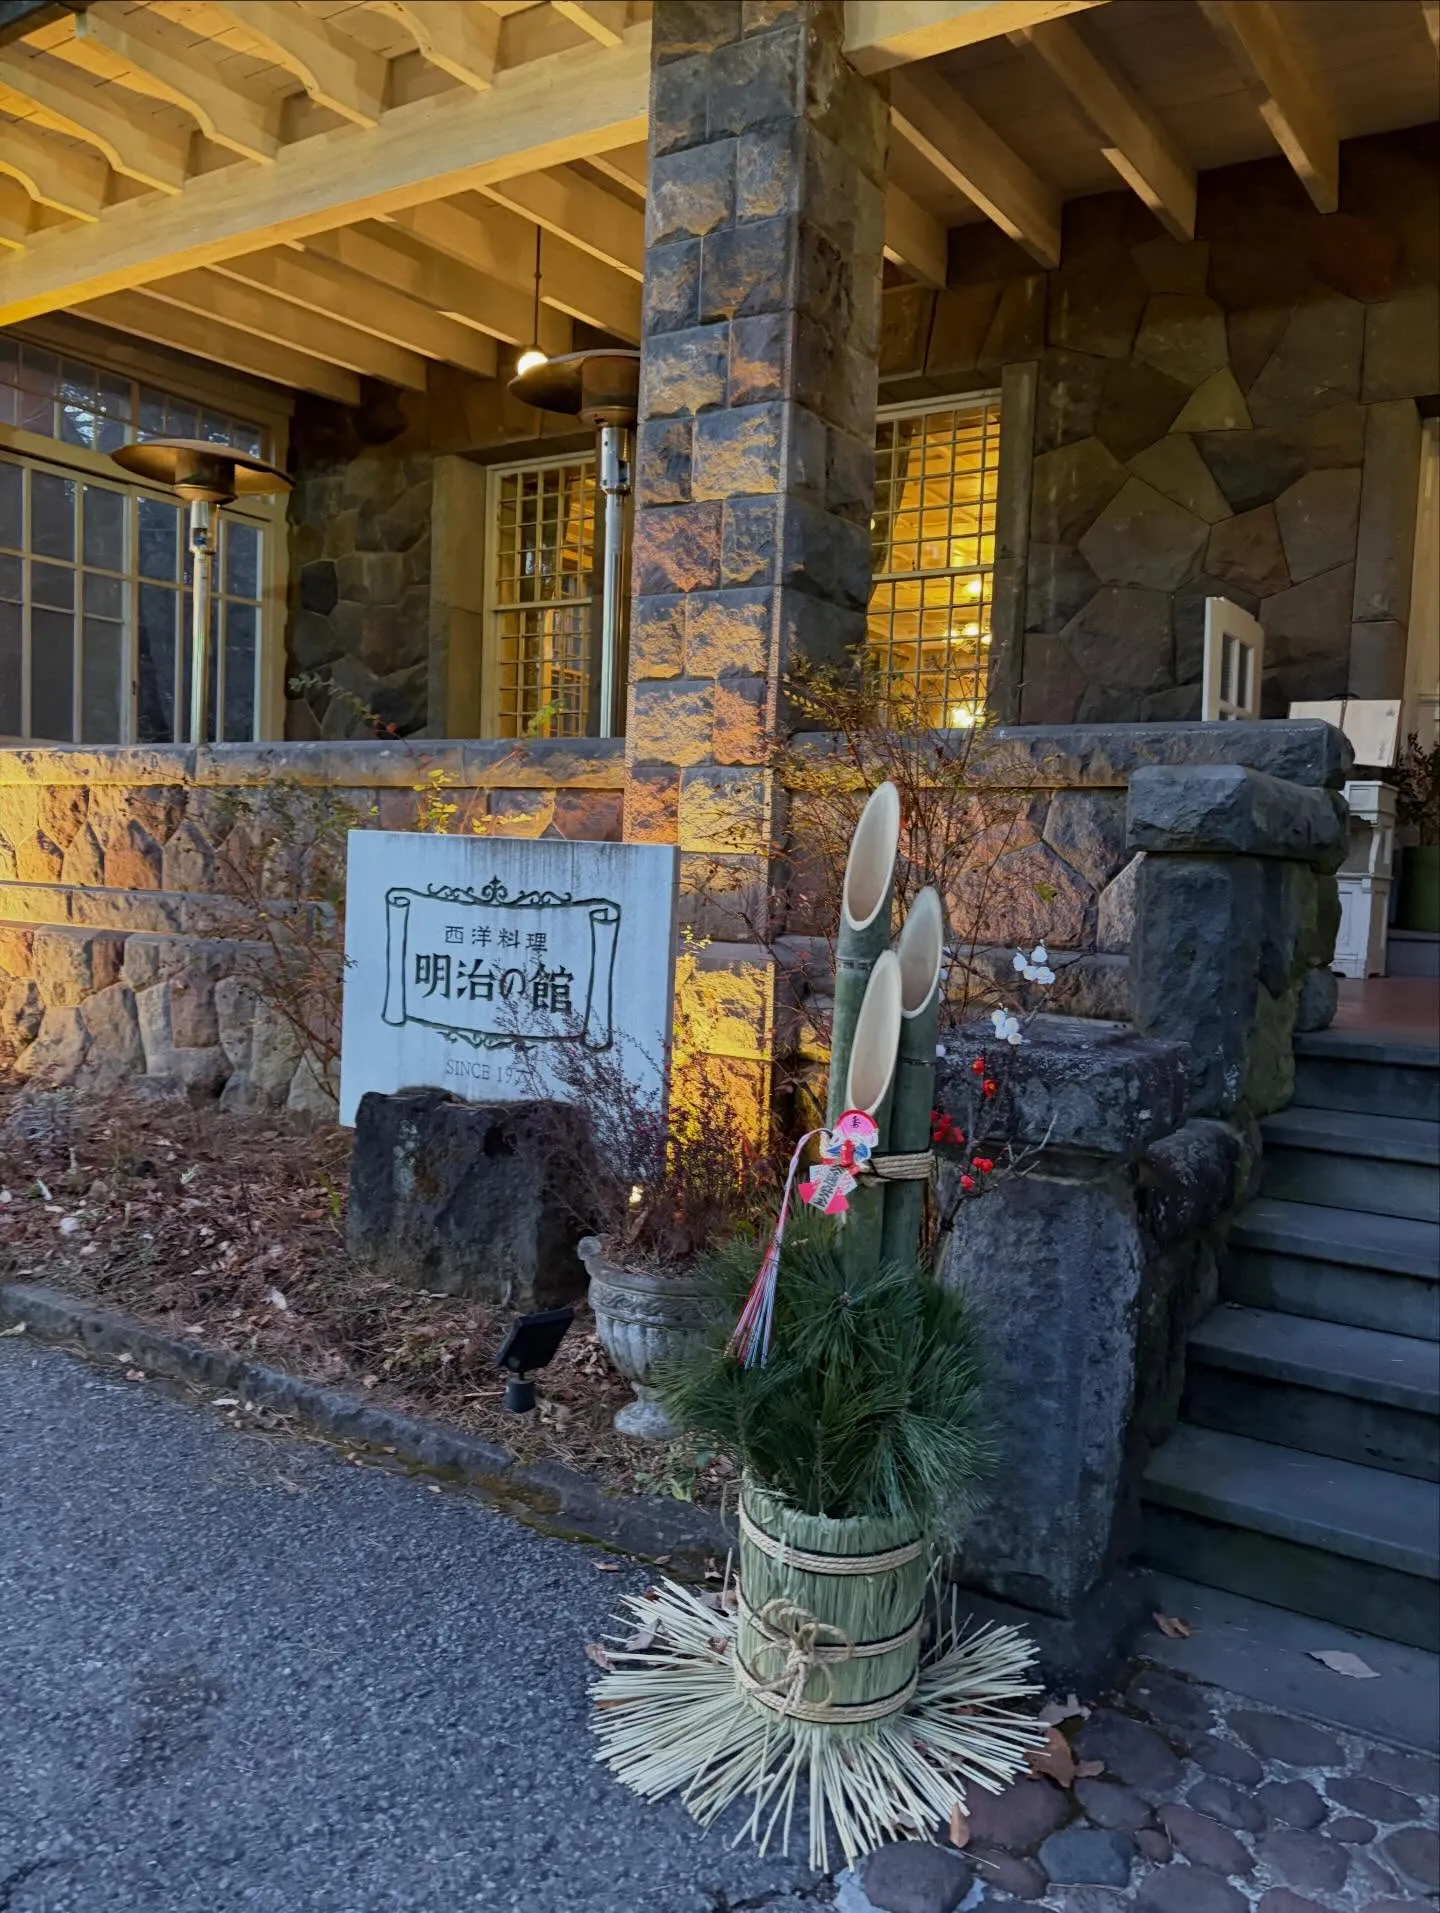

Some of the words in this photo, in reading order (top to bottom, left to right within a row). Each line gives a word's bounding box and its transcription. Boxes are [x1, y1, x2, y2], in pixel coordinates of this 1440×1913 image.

[445, 925, 548, 952] 西洋料理
[415, 952, 575, 1015] 明治の館
[446, 1060, 490, 1080] SINCE
